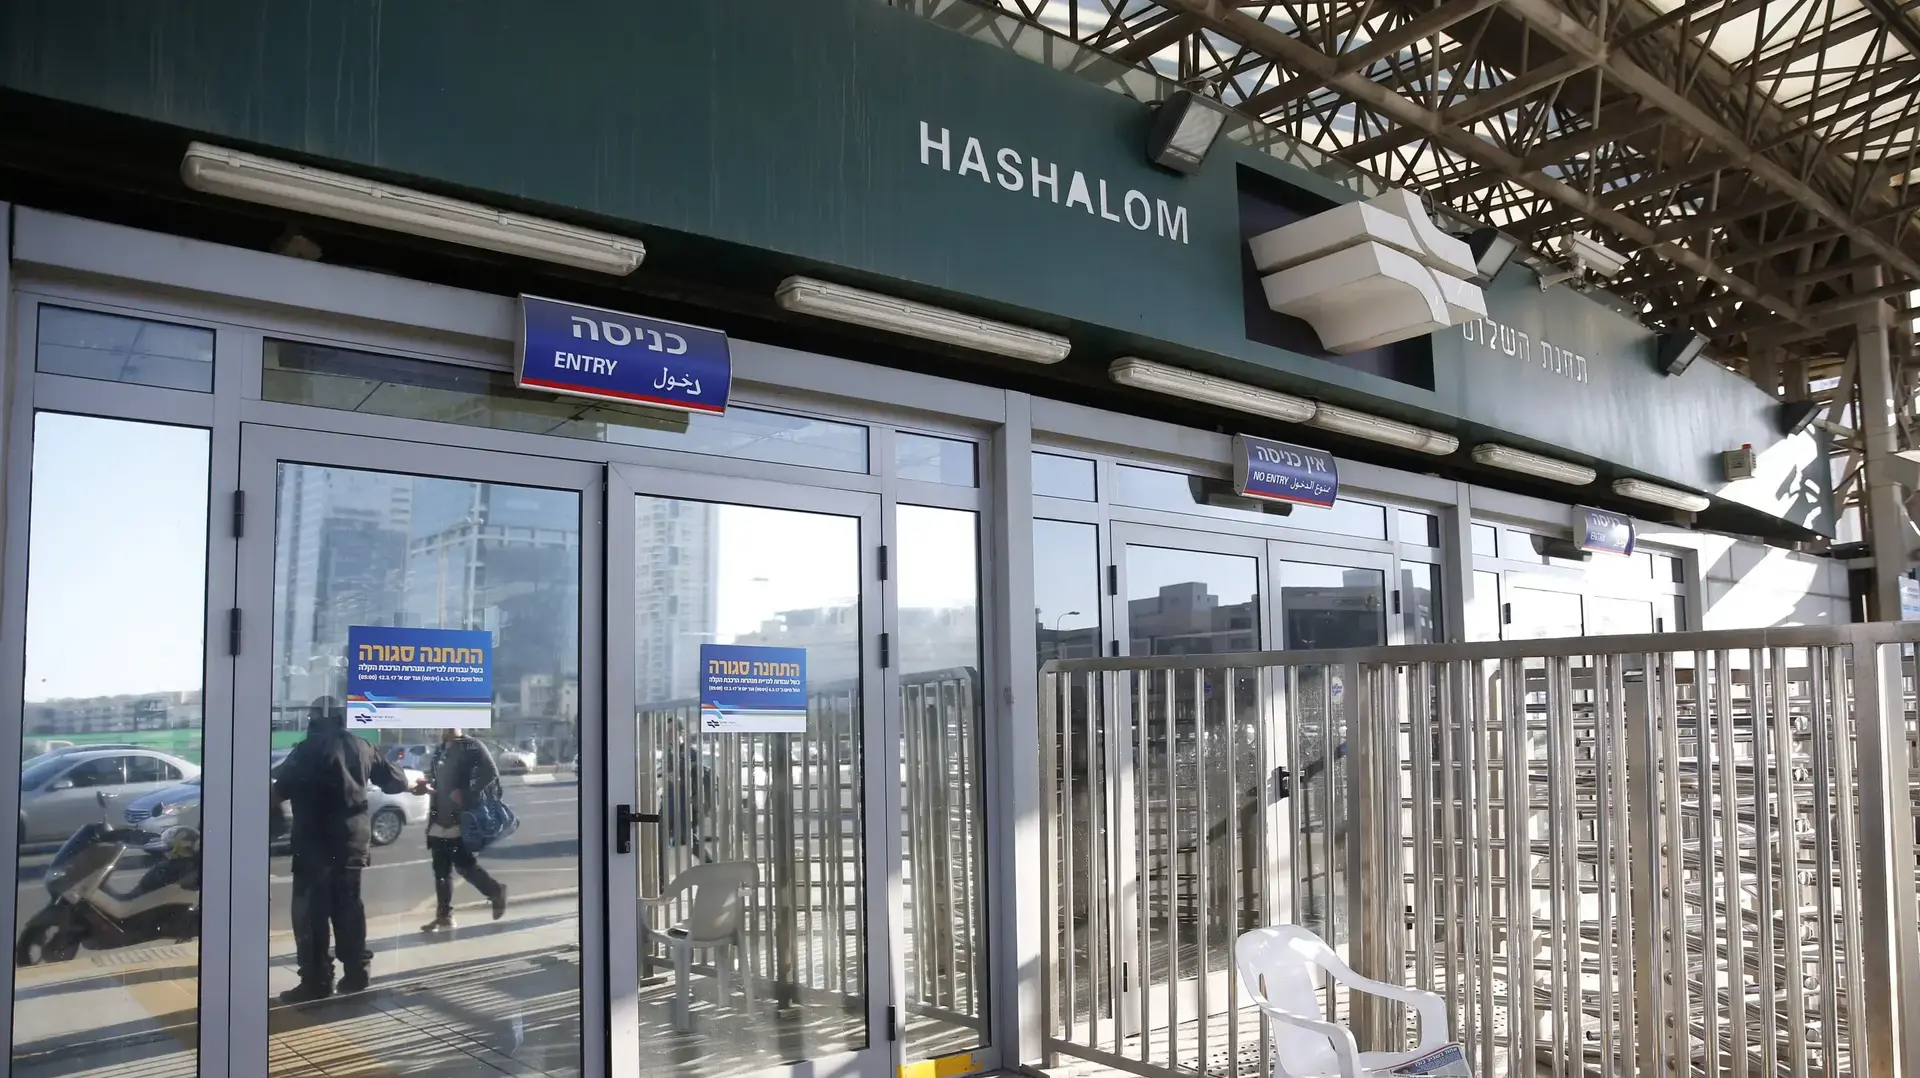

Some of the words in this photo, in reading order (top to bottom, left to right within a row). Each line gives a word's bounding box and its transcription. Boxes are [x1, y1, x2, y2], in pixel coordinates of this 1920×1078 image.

[920, 120, 1189, 245] HASHALOM
[571, 315, 688, 355] כניסה
[554, 351, 618, 376] ENTRY
[1540, 340, 1588, 384] תחנת
[653, 367, 702, 395] دخول
[1256, 445, 1302, 467] כניסה
[1304, 455, 1327, 474] אין
[1253, 470, 1265, 481] NO
[1266, 473, 1290, 486] ENTRY
[1290, 477, 1315, 490] الدخول
[359, 644, 416, 663] סגורה
[419, 646, 483, 664] התחנה
[358, 663, 378, 673] הקלה
[378, 664, 401, 672] הרכבת
[469, 666, 484, 674] בשל
[709, 659, 750, 676] סגורה
[753, 661, 800, 677] התחנה
[358, 673, 378, 681] (05:00)
